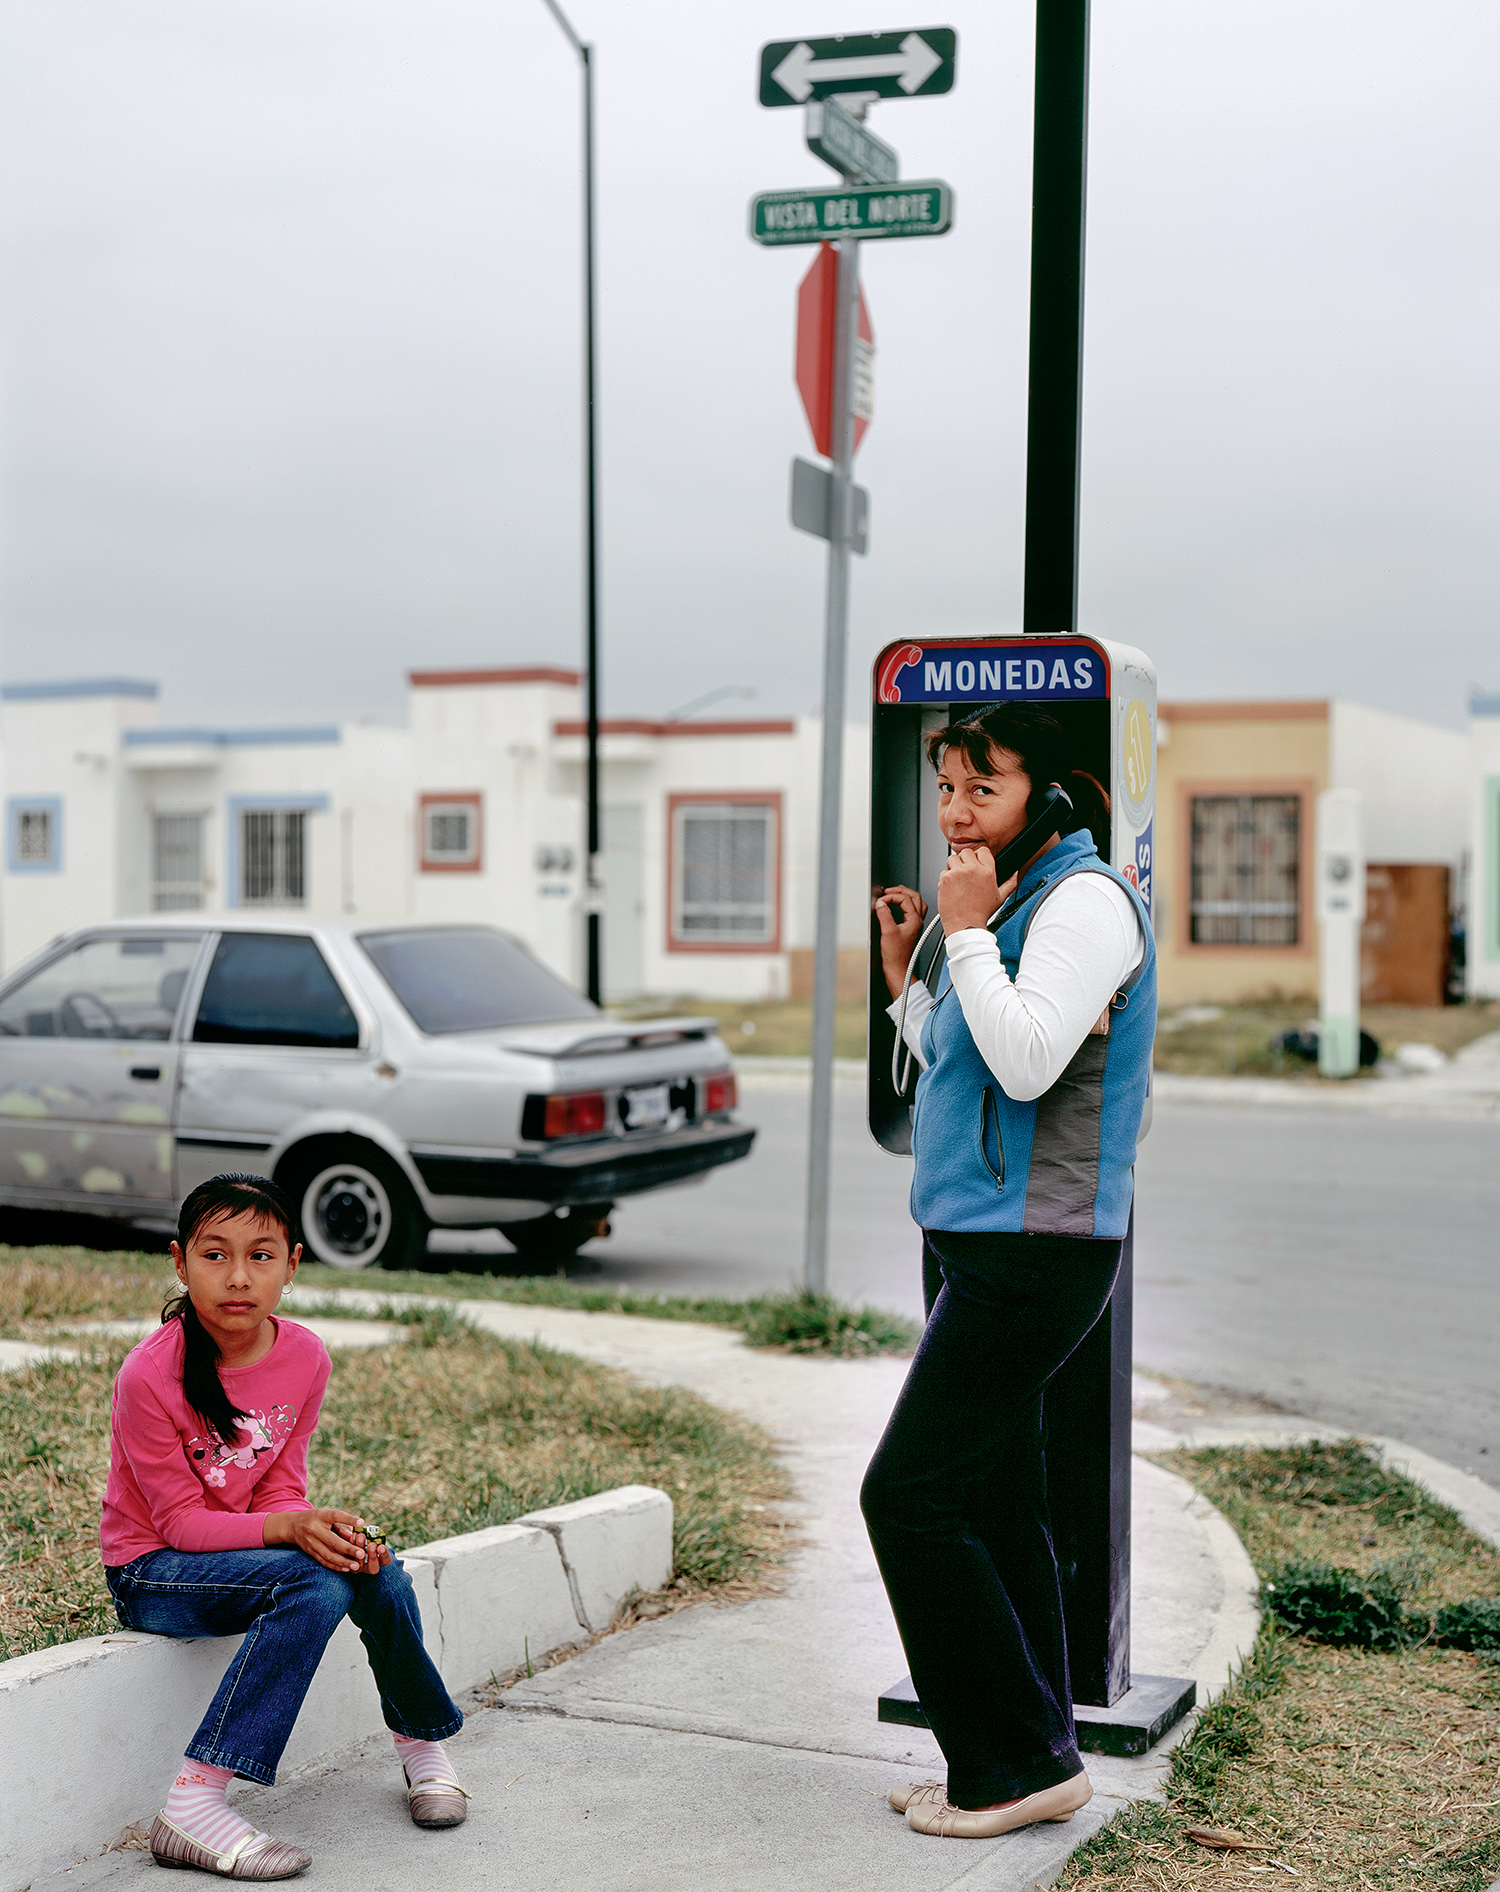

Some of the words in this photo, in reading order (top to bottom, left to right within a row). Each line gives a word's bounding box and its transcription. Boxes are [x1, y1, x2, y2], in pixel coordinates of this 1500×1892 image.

[764, 201, 818, 229] VISTA
[825, 198, 862, 226] DEL
[869, 194, 932, 222] NORTE
[924, 657, 1093, 692] MONEDAS
[1139, 844, 1150, 905] AS
